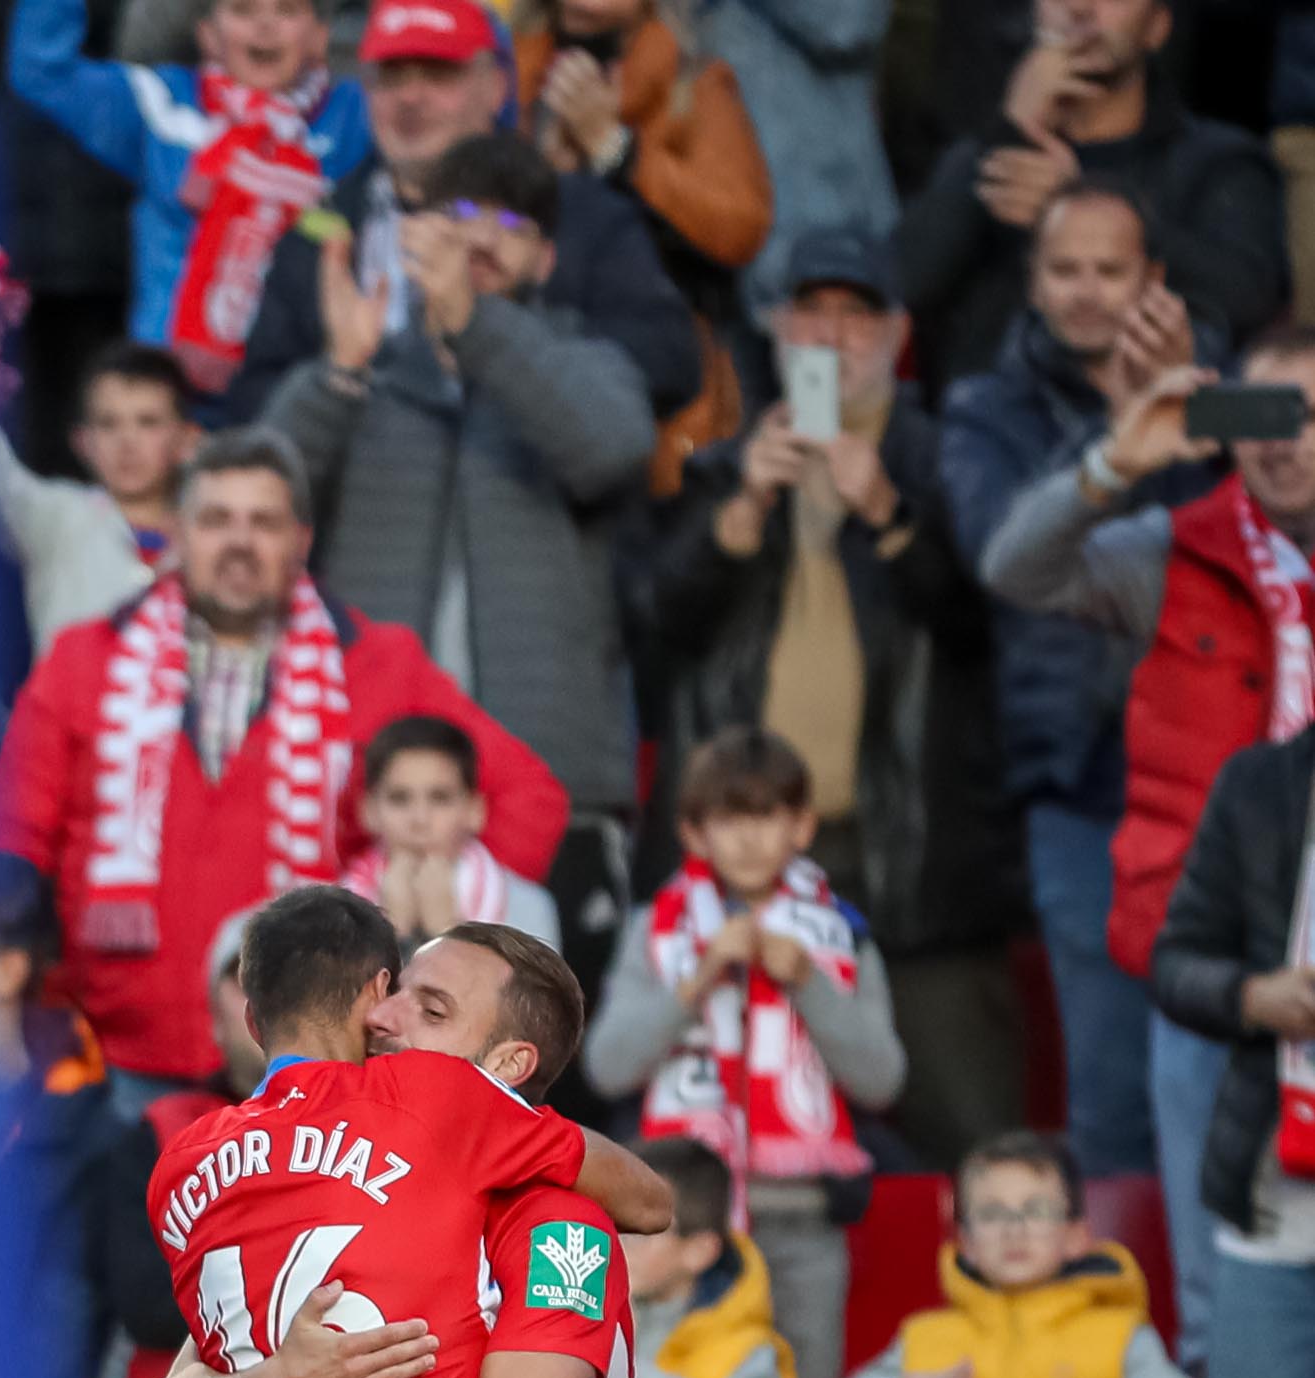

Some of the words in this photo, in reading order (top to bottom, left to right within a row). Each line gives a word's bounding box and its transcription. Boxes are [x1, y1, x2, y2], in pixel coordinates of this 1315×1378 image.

[161, 1129, 271, 1252] VÍCTOR
[289, 1120, 412, 1206] DÍAZ
[532, 1284, 564, 1298] CAJA
